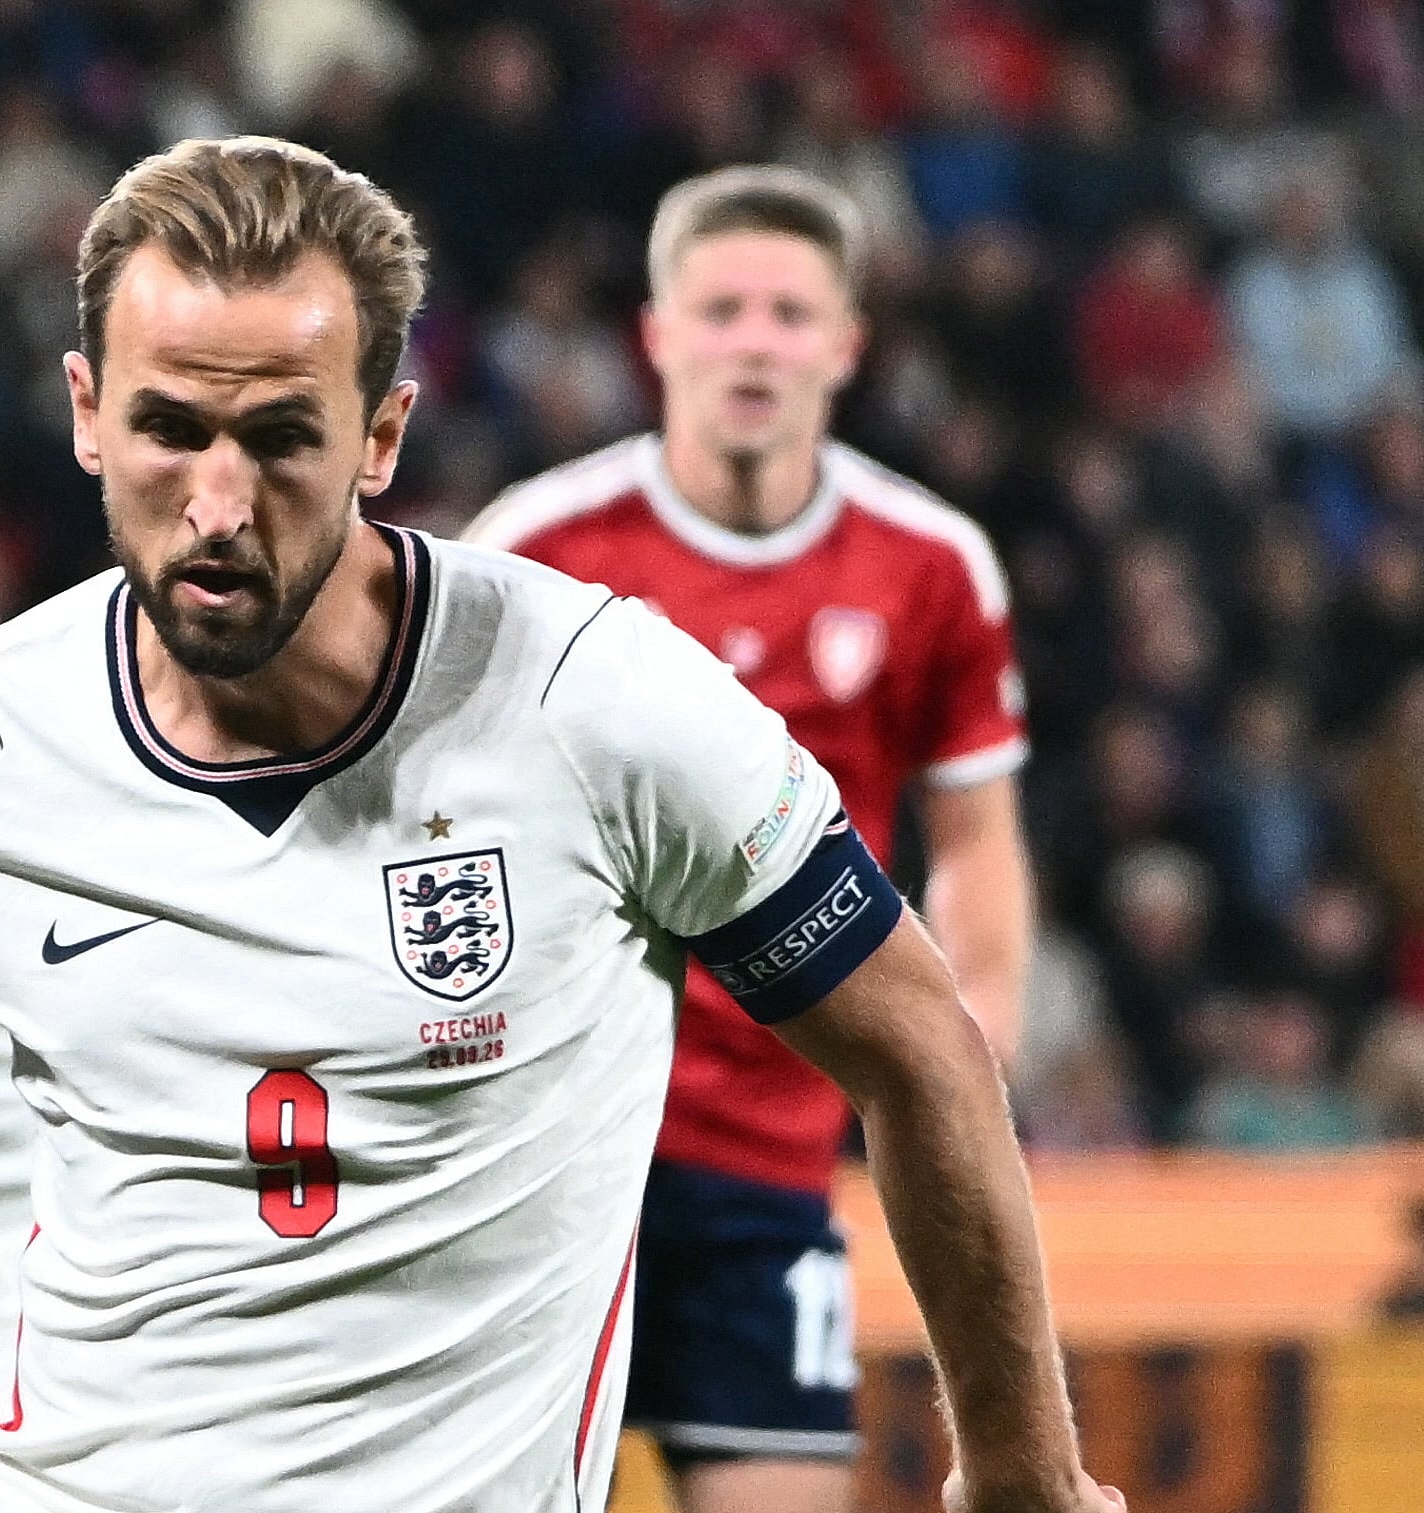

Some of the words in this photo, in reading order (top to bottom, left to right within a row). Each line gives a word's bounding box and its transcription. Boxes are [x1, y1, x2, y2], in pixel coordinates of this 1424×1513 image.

[748, 874, 864, 980] RESPECT
[419, 1011, 507, 1044] CZECHIA
[246, 1067, 339, 1239] 9
